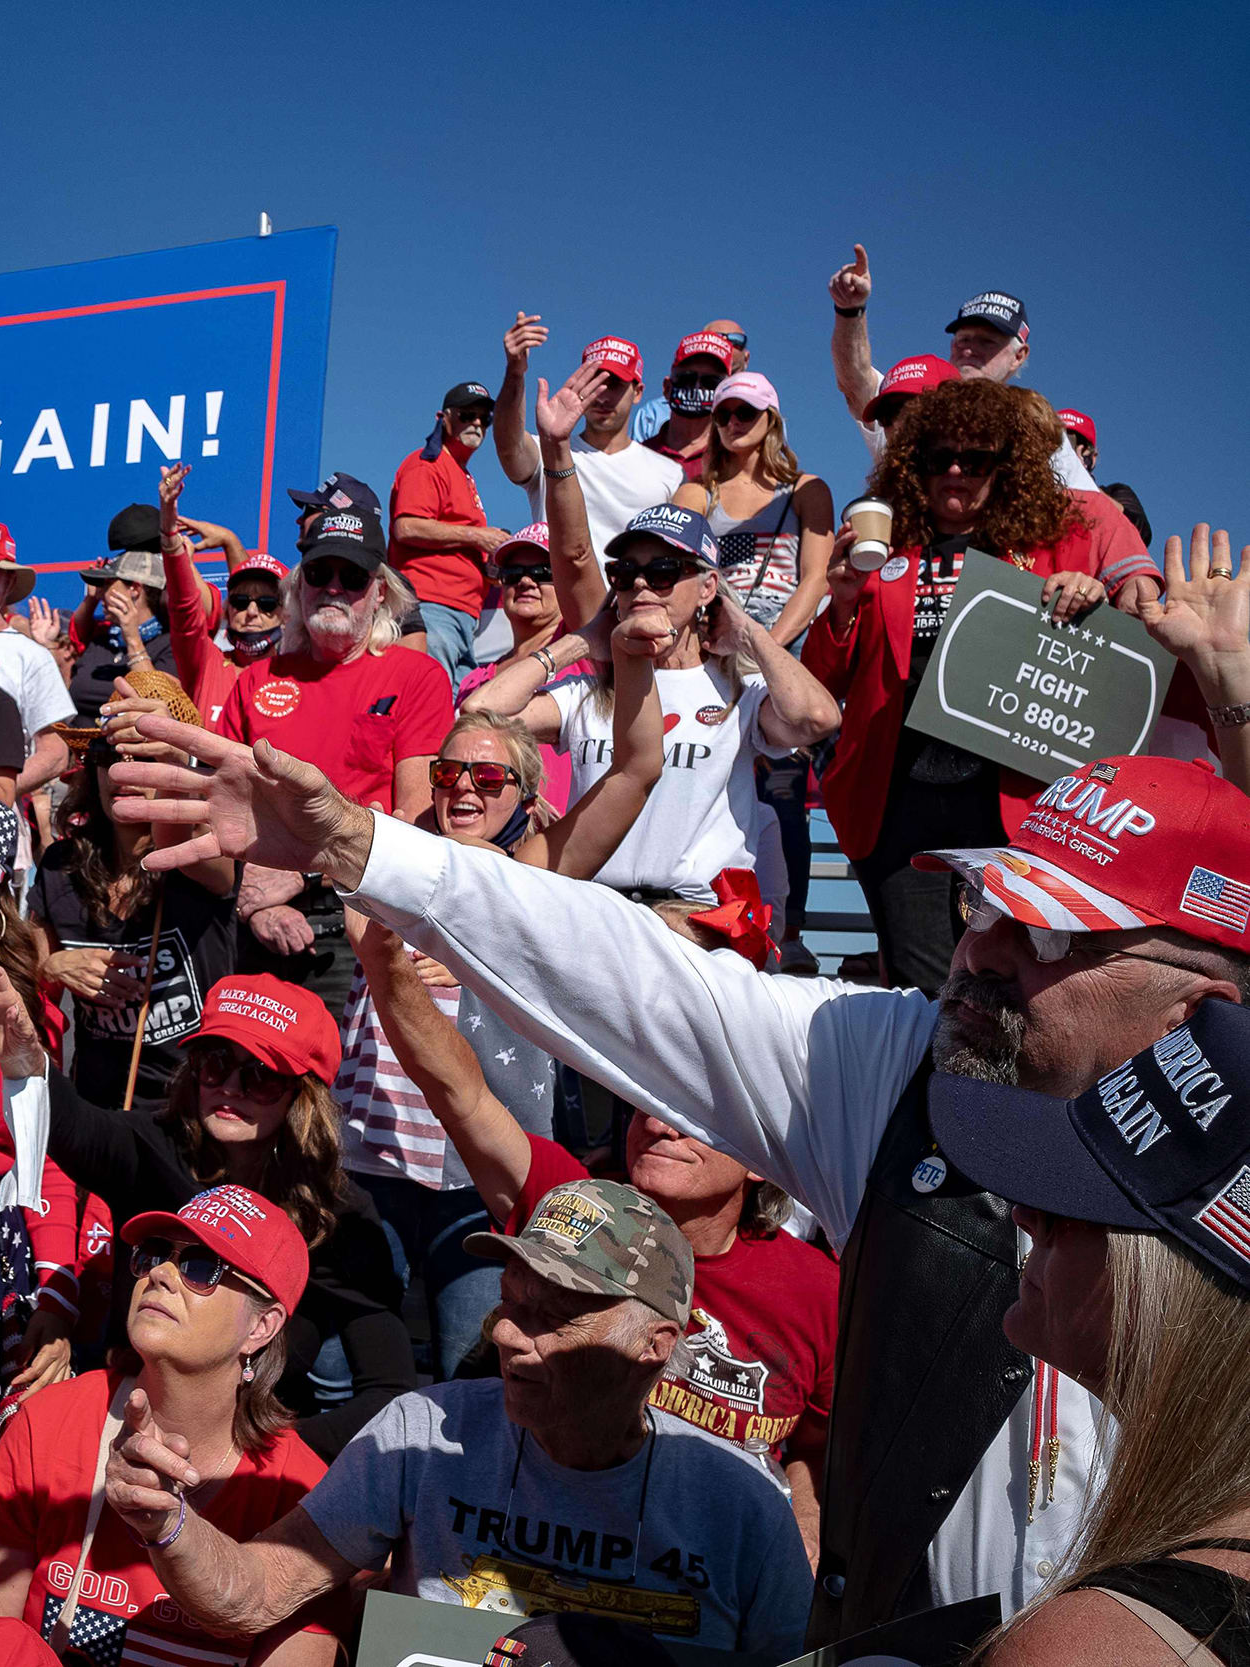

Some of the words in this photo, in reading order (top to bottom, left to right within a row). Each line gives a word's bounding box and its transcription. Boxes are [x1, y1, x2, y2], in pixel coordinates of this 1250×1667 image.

[983, 292, 1020, 313] AMERICA
[986, 305, 1013, 322] AGAIN
[601, 339, 635, 357] AMERICA
[605, 352, 629, 366] AGAIN
[893, 363, 928, 376] AMERICA
[898, 371, 924, 381] AGAIN
[633, 507, 691, 525] TRUMP
[1036, 633, 1095, 676] TEXT
[265, 691, 293, 699] TRUMP
[1015, 661, 1089, 708] FIGHT
[987, 684, 1019, 716] TO
[1023, 702, 1096, 749] 88022
[1011, 732, 1049, 755] 2020
[1068, 838, 1113, 866] GREAT
[217, 1001, 251, 1017] GREAT
[249, 1008, 288, 1033] AGAIN
[218, 988, 245, 1002] MAKE
[244, 992, 298, 1024] AMERICA
[154, 1022, 186, 1040] GREAT
[912, 1160, 945, 1188] PETE
[182, 1210, 219, 1227] MAGA
[534, 1217, 583, 1240] TRUMP
[87, 1222, 112, 1256] 45
[692, 1368, 757, 1399] DEPLORABLE
[449, 1497, 634, 1571] TRUMP
[651, 1546, 711, 1590] 45
